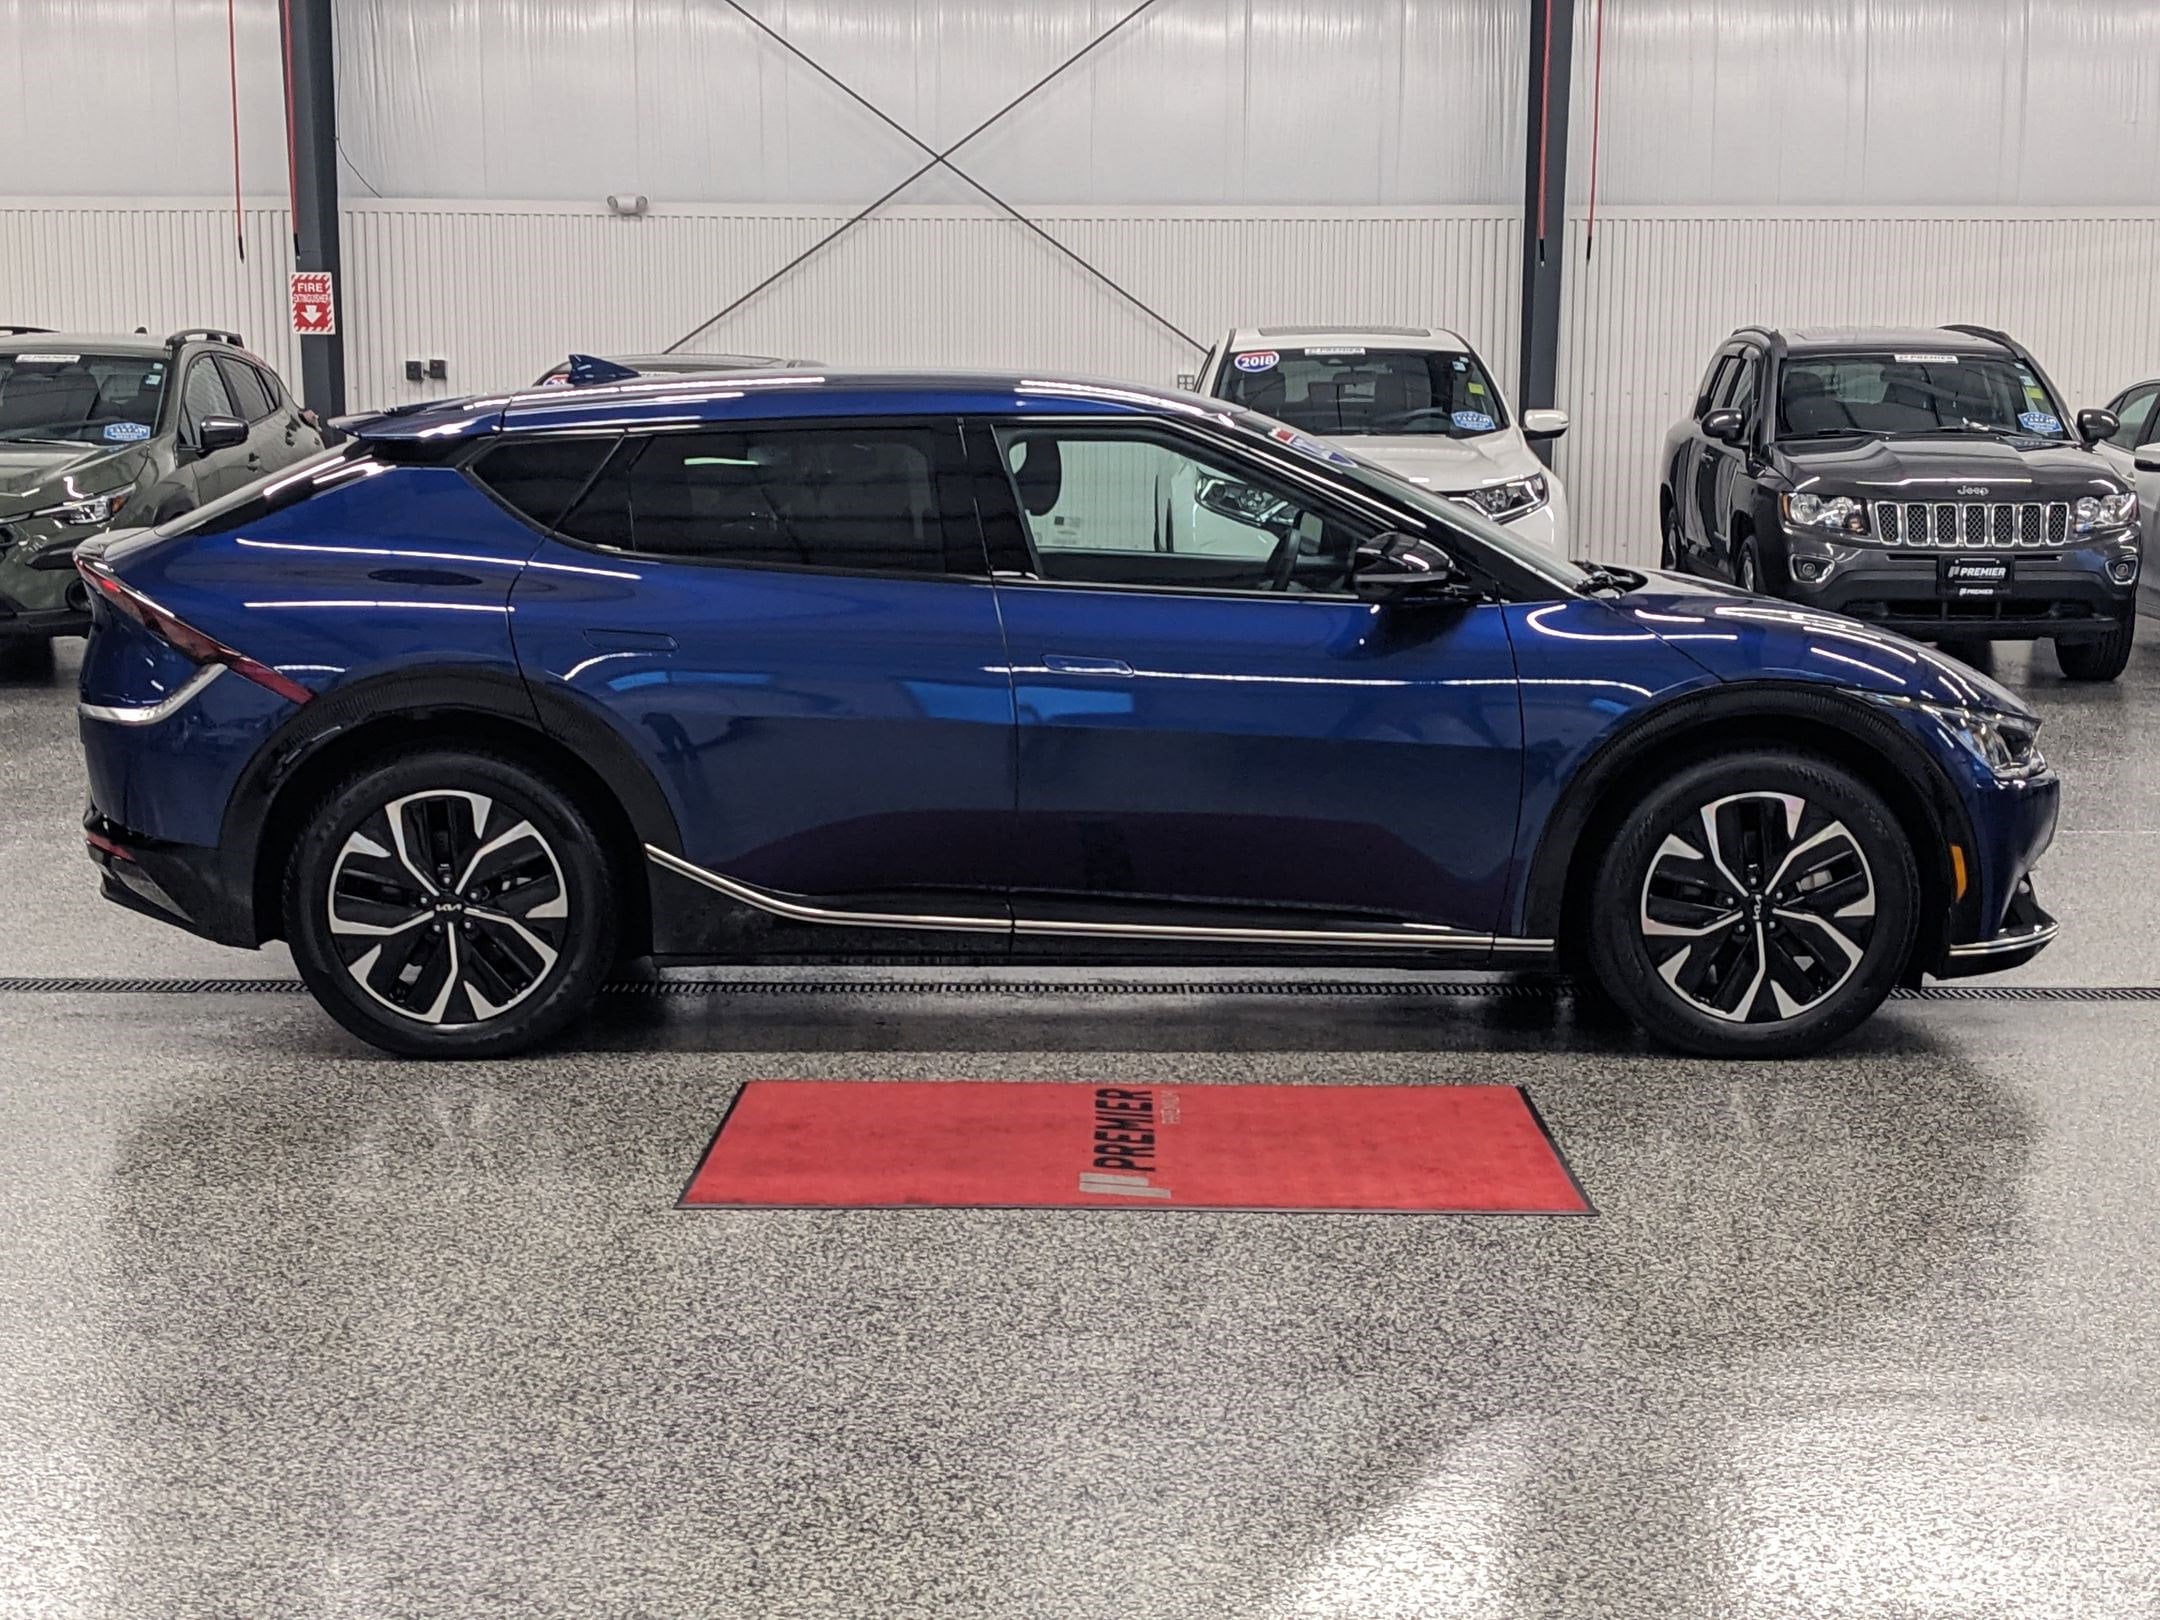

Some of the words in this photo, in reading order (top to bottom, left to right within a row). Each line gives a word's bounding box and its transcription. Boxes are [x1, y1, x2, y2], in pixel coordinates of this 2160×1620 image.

[298, 283, 323, 293] FIRE
[1241, 355, 1274, 367] 2018
[1957, 485, 1988, 496] Jeep
[1959, 567, 2006, 577] PREMIER
[1093, 1089, 1155, 1171] PREMIER
